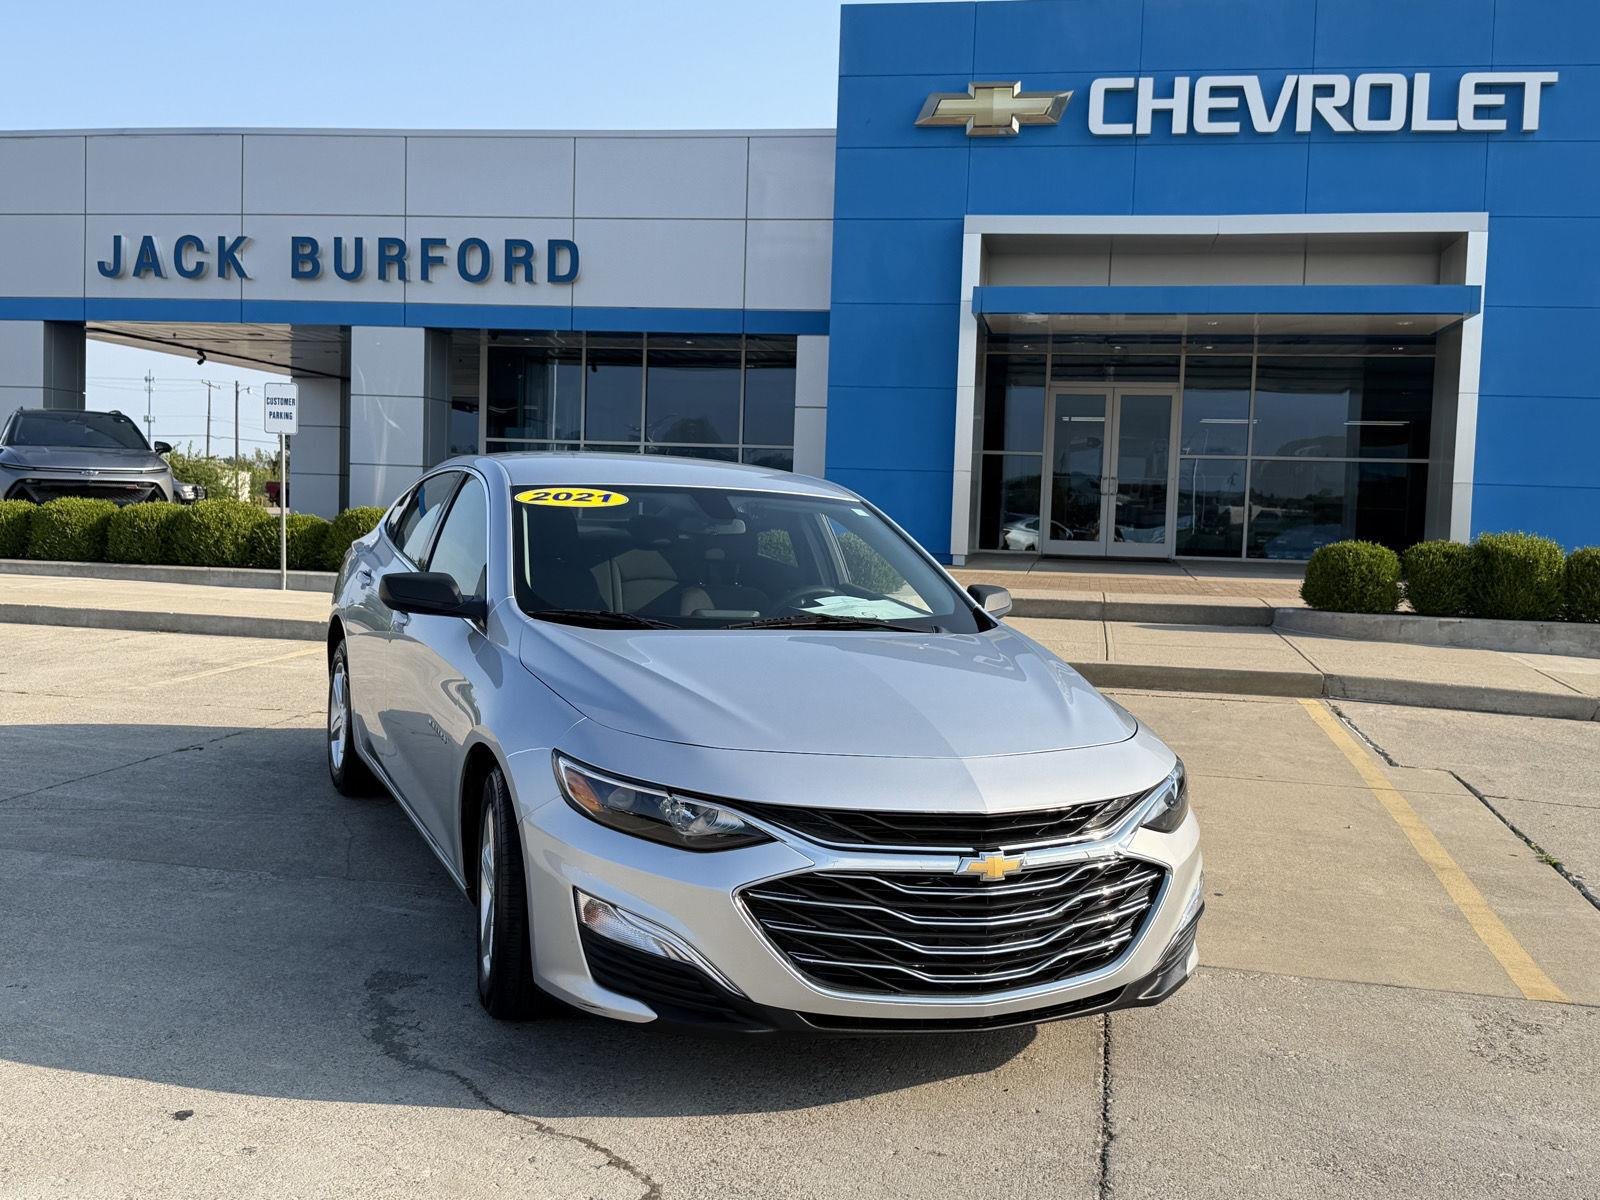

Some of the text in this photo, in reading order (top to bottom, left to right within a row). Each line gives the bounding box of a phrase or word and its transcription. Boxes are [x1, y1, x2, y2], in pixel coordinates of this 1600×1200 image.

[1088, 71, 1560, 136] CHEVROLET
[97, 234, 581, 284] JACK BURFORD
[266, 397, 296, 406] CUSTOMER
[268, 411, 293, 420] PARKING
[528, 491, 613, 503] 2021
